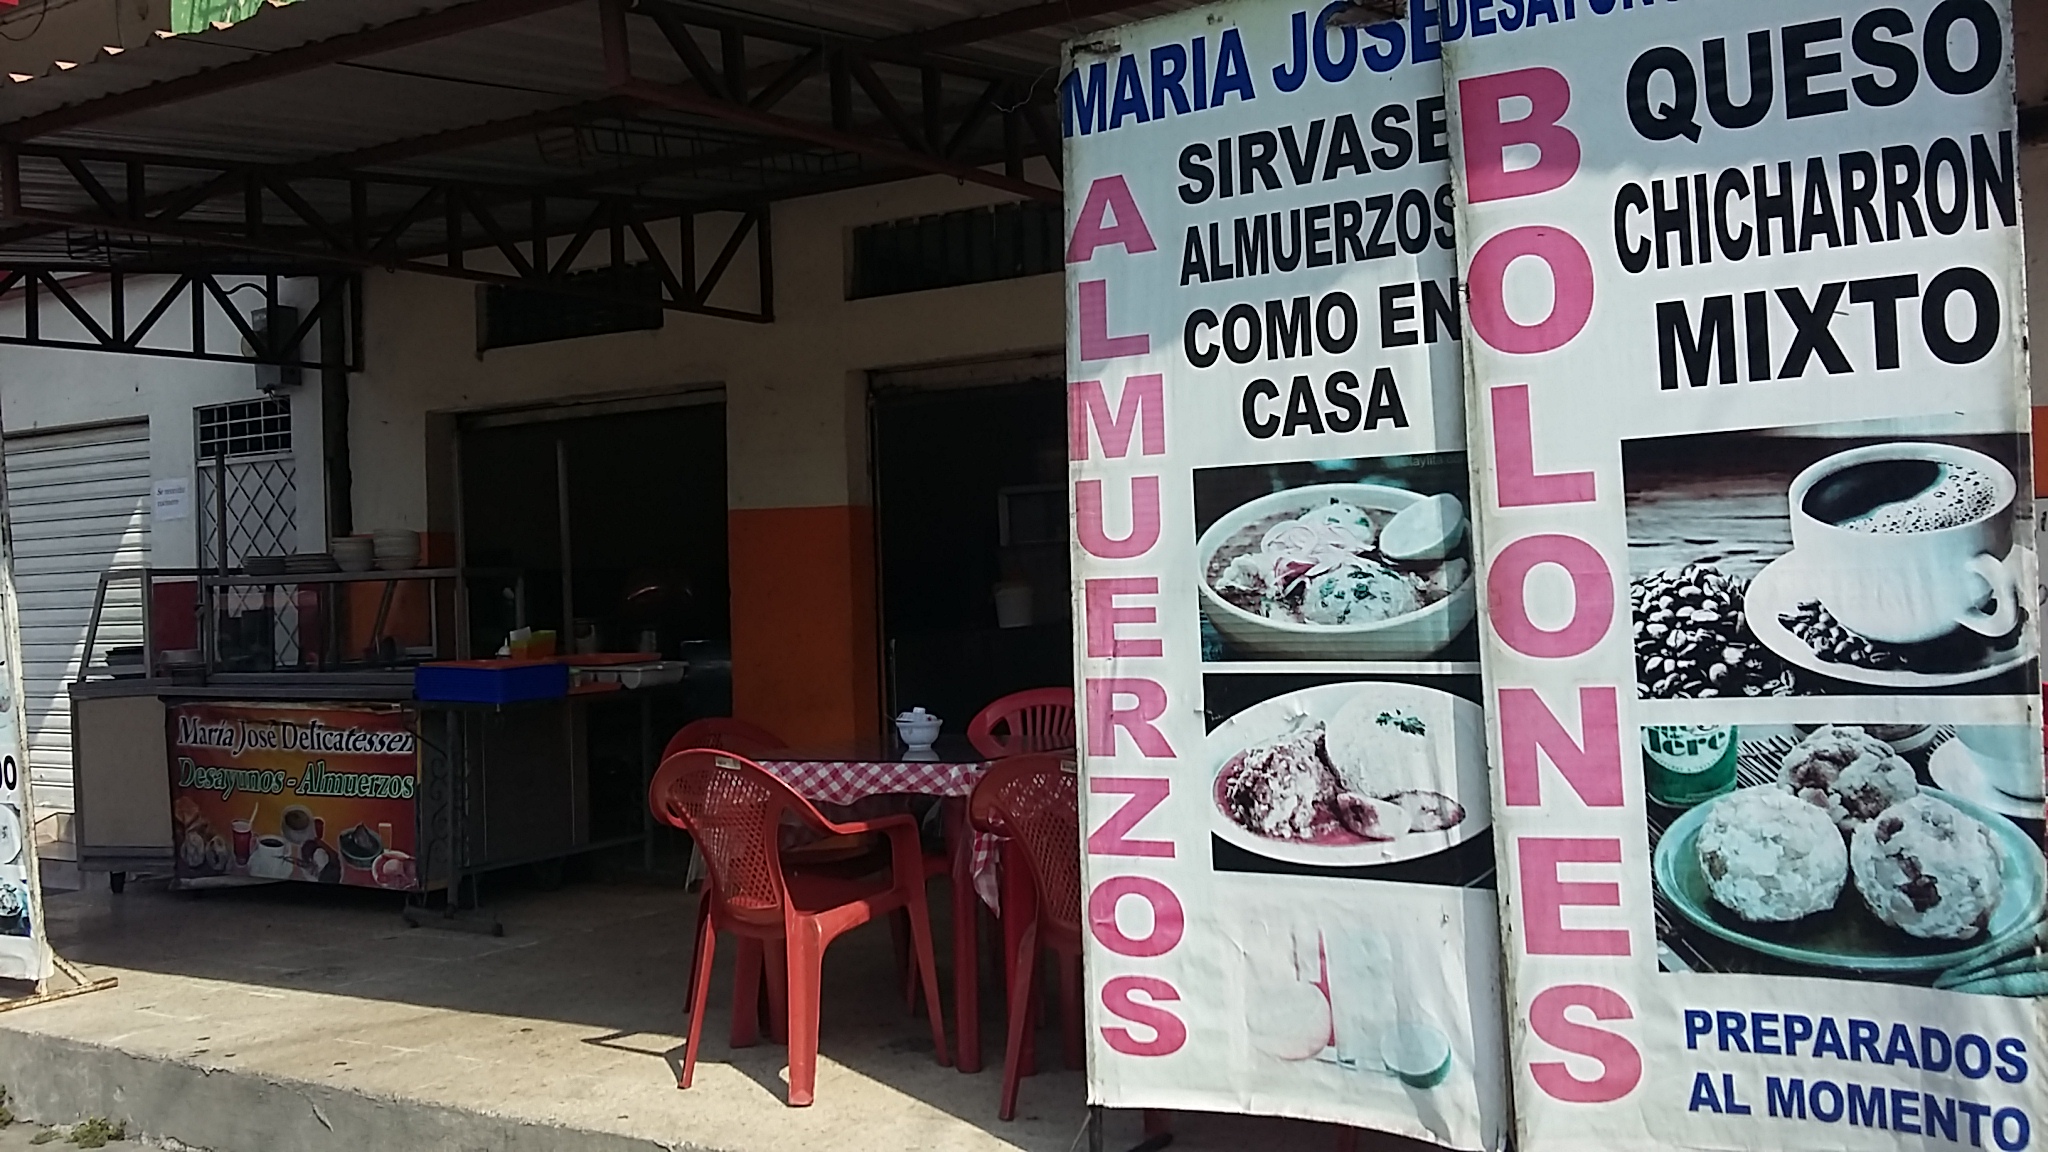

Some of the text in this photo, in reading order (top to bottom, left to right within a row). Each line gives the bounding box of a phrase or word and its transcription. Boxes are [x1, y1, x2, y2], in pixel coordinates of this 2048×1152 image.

[1061, 0, 1442, 139] MARIA JOSE
[1626, 0, 2003, 144] QUESO
[1177, 95, 1448, 205] SIRVASE
[1614, 129, 2018, 274] CHICHARRON
[1179, 183, 1456, 287] ALMUERZOS
[1183, 277, 1462, 369] COMO EN
[1655, 266, 2001, 391] MIXTO
[1242, 367, 1410, 440] CASA
[1064, 174, 1188, 1058] ALMUERZOS
[1459, 66, 1643, 1104] BOLONES
[178, 715, 415, 757] María José Delicatessen
[178, 757, 286, 801] Desayunos
[296, 759, 415, 799] Almuerzos
[1684, 1009, 2029, 1084] PREPARADOS
[1688, 1071, 2031, 1152] AL MOMENTO
